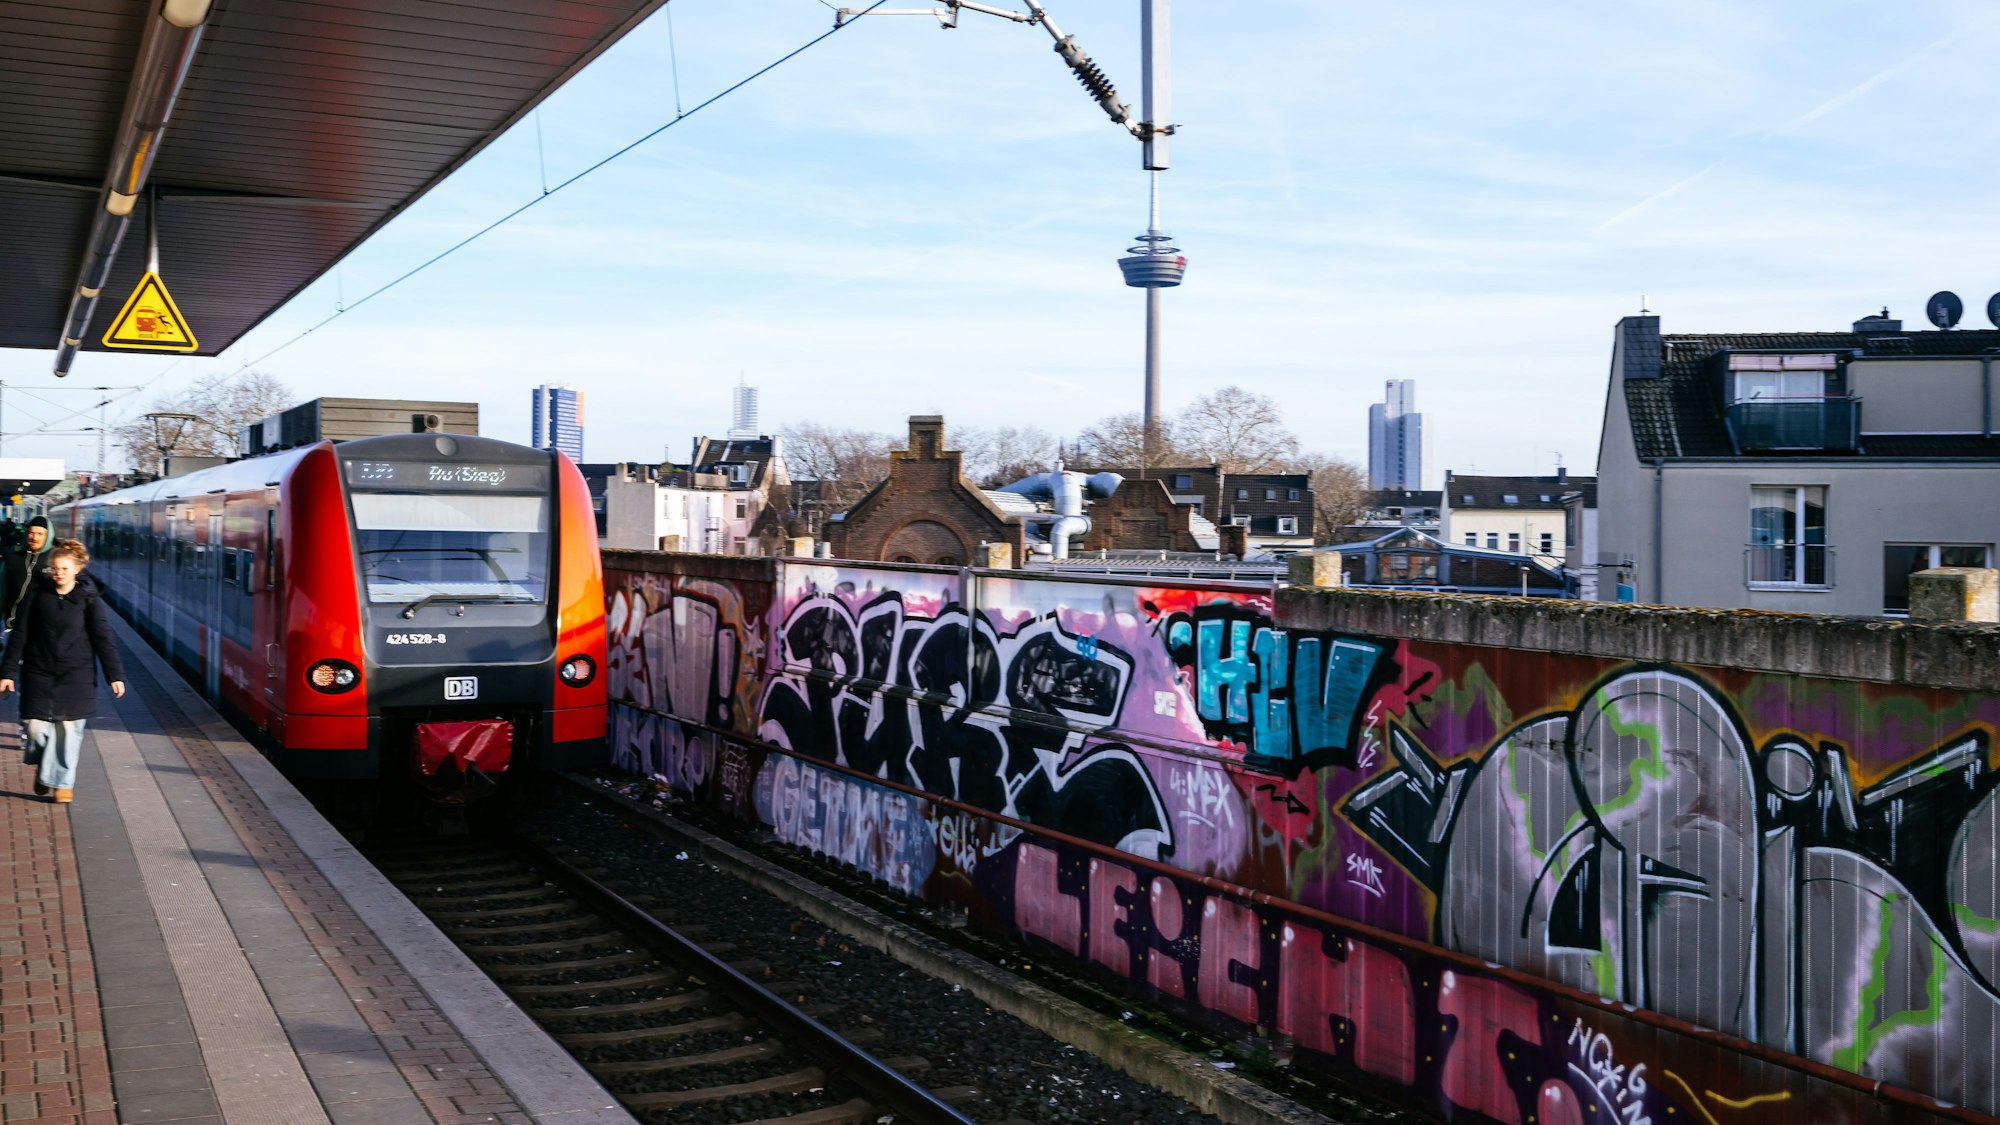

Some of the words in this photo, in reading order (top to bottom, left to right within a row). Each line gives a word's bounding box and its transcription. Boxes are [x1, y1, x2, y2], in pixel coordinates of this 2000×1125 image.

[455, 466, 506, 485] (Sieg)
[447, 678, 475, 698] DB
[1346, 852, 1387, 895] SMK
